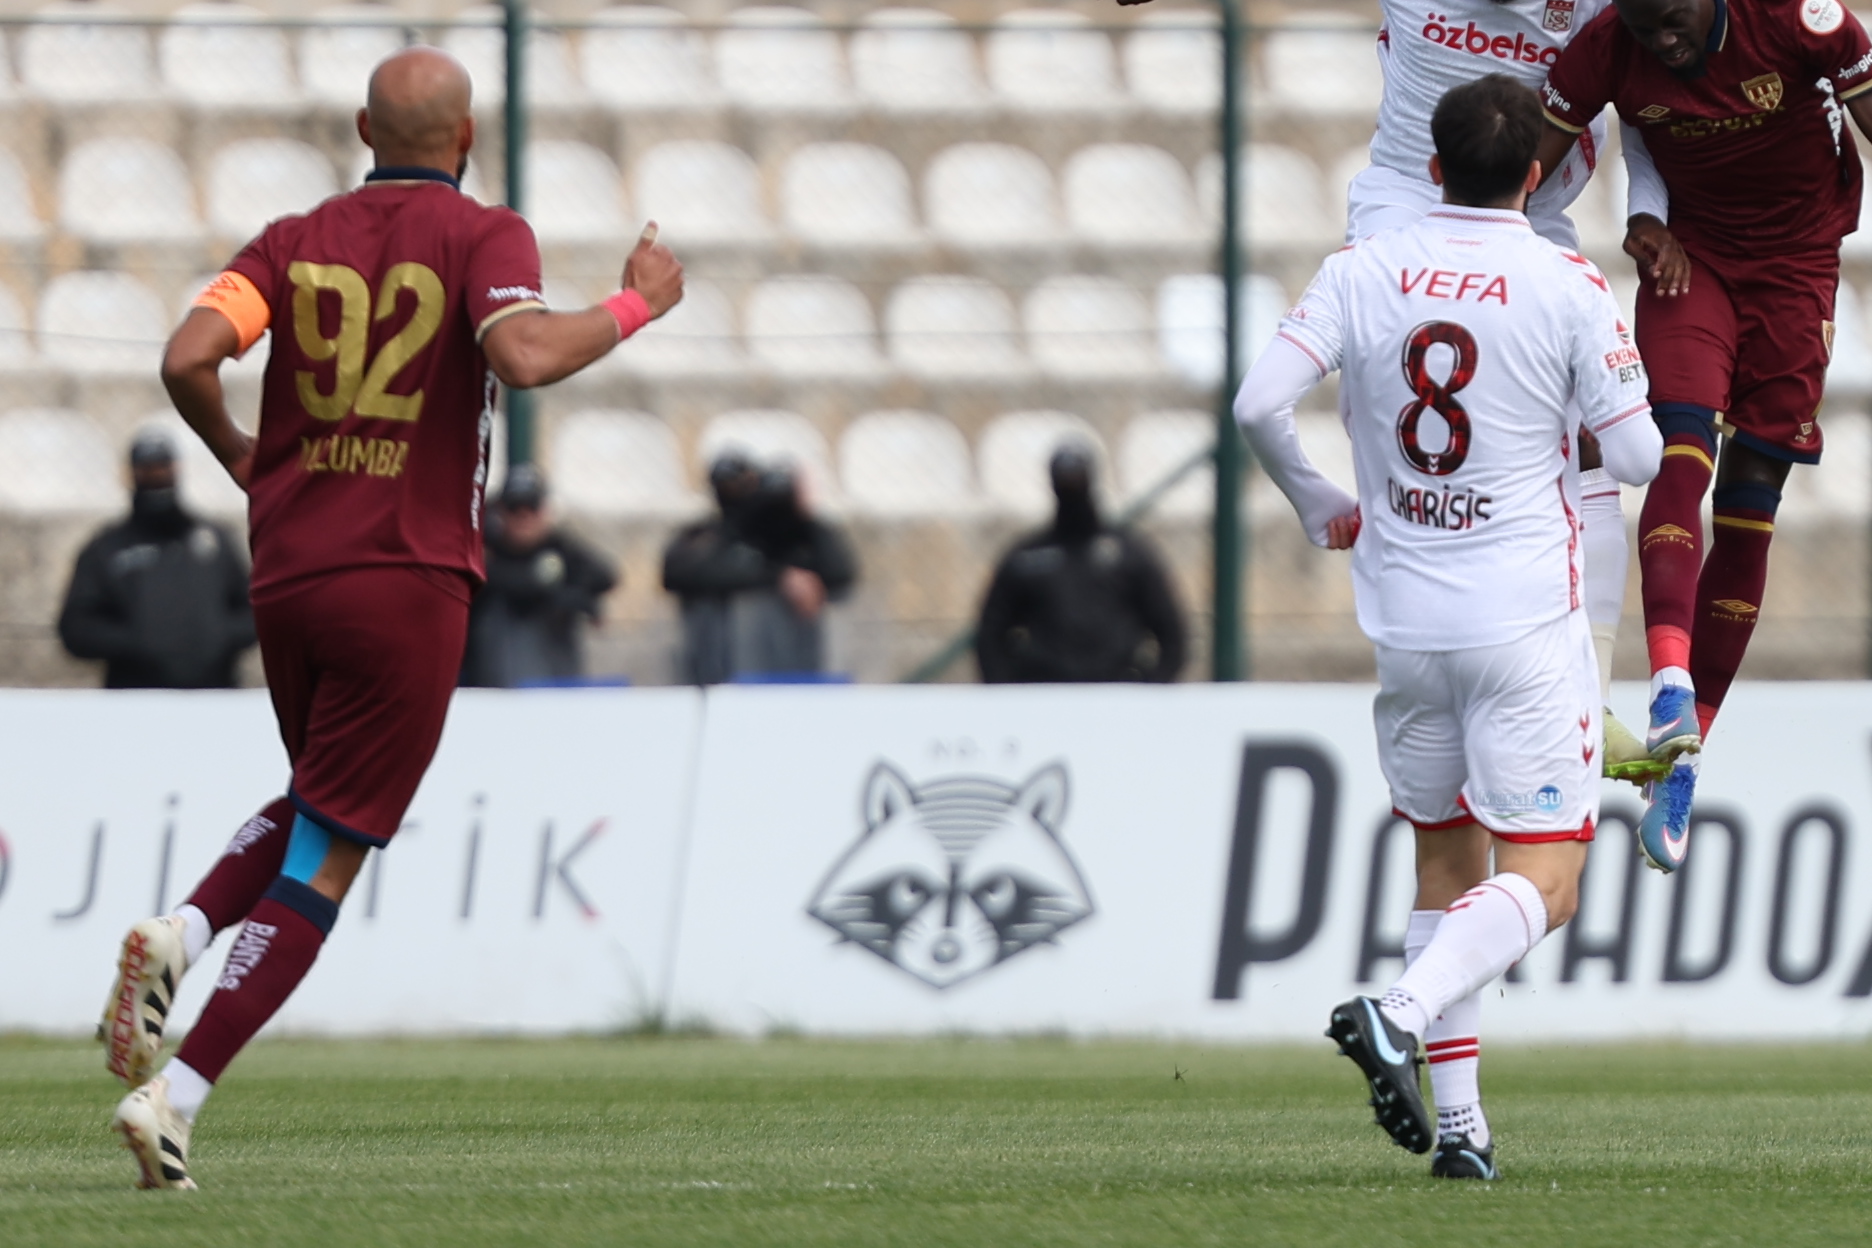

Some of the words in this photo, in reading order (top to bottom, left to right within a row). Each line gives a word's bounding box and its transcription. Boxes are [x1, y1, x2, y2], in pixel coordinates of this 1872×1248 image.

[1422, 12, 1564, 68] özbelsa
[1400, 266, 1508, 306] VEFA
[287, 259, 446, 422] 92
[1396, 319, 1480, 477] 8
